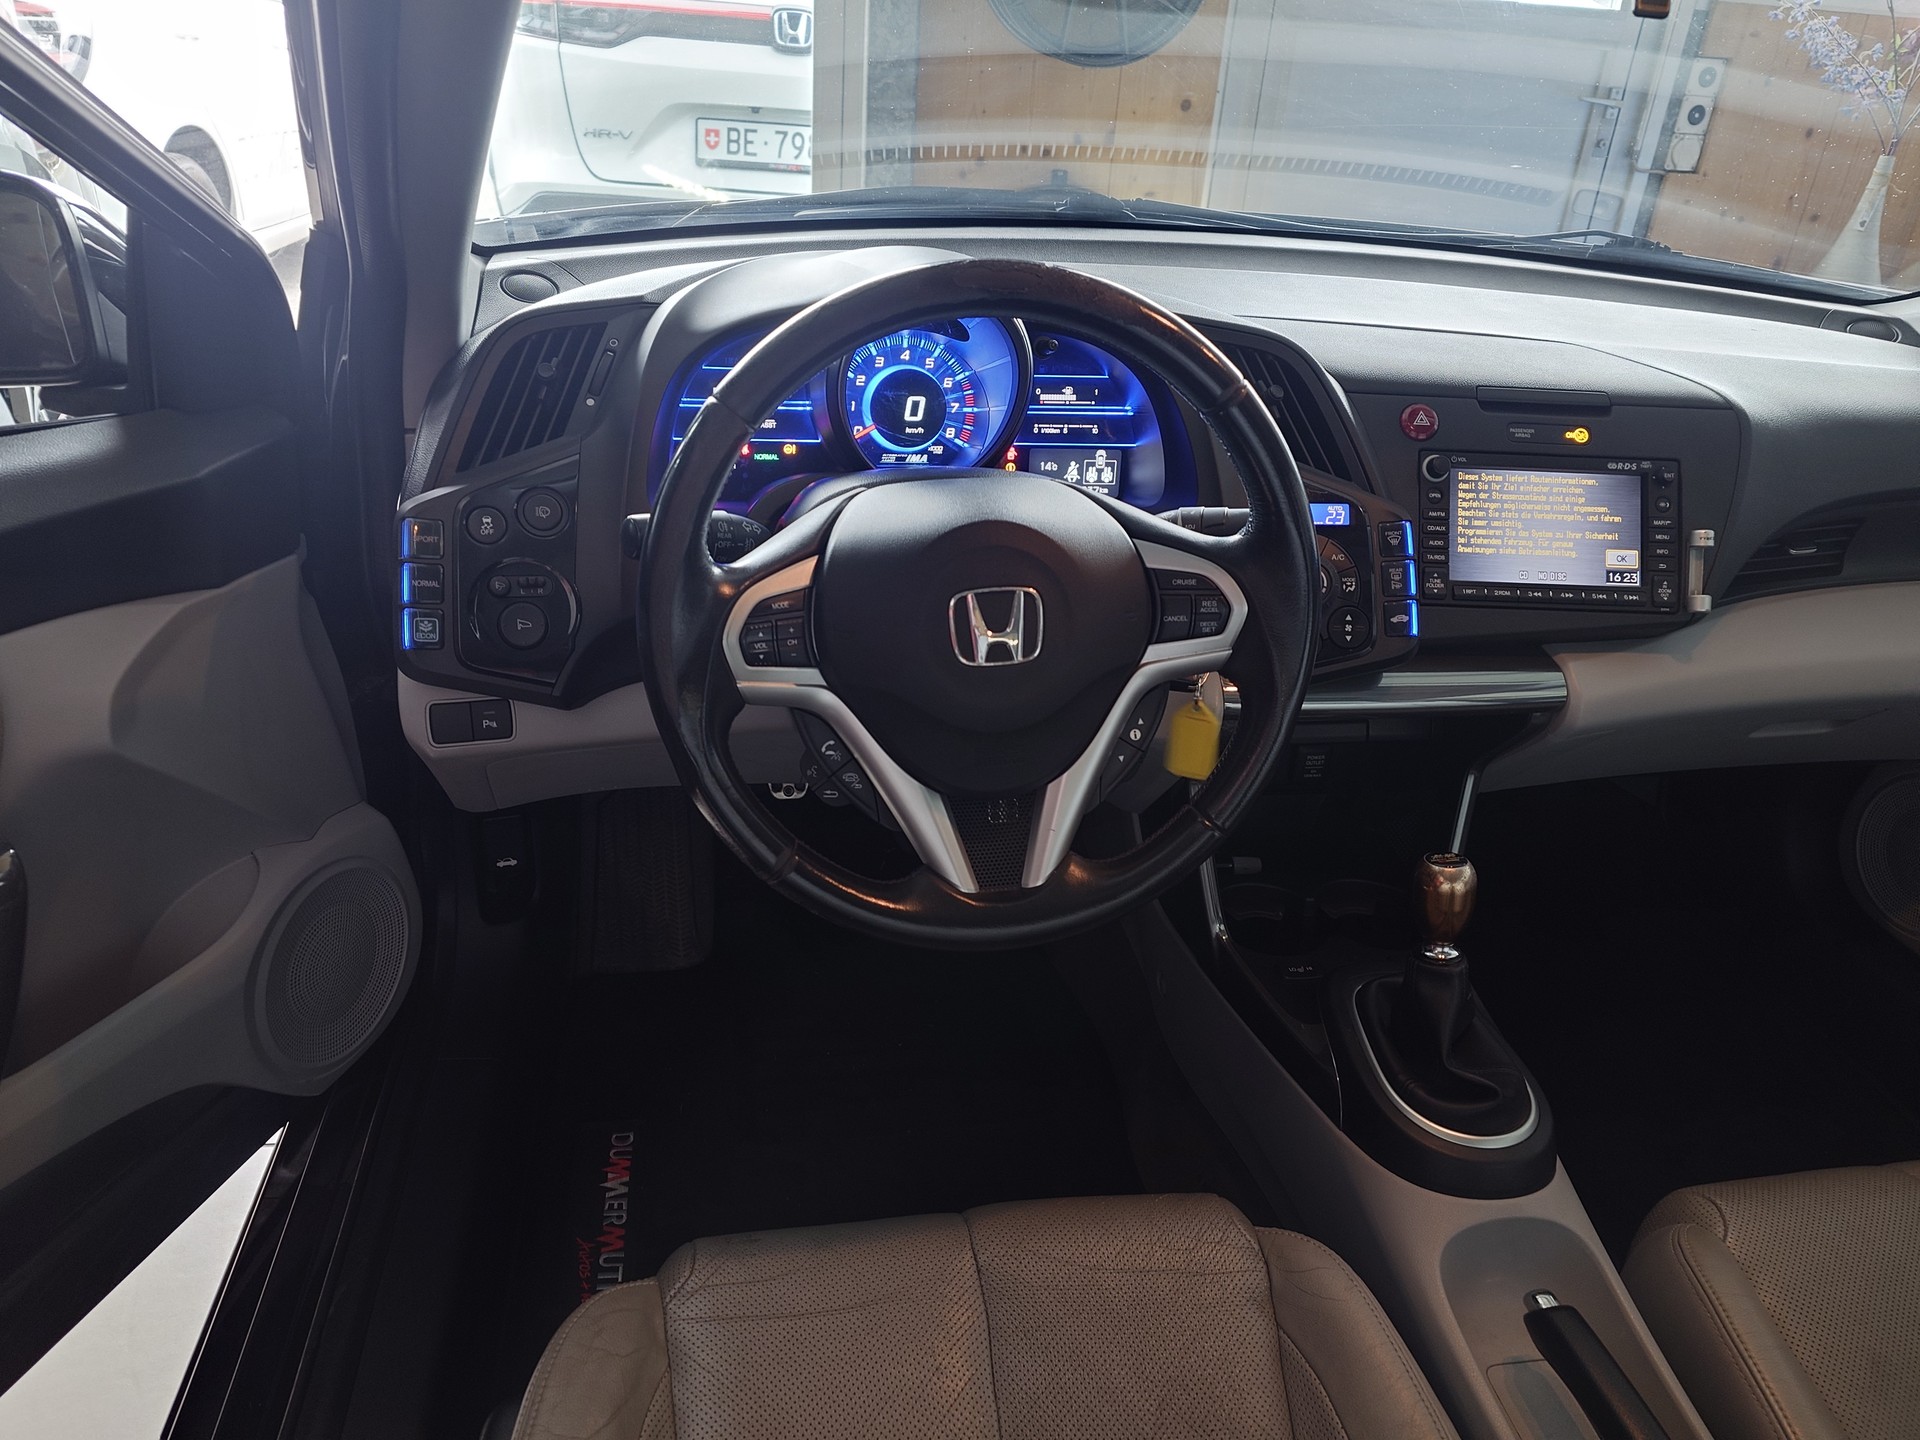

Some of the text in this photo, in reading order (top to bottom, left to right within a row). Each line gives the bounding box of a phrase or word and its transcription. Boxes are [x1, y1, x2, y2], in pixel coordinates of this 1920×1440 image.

[583, 127, 634, 140] HR-V
[900, 349, 911, 361] 4
[874, 356, 885, 368] 3
[924, 357, 935, 369] 5
[855, 374, 866, 386] 2
[943, 377, 954, 388] 6
[850, 400, 856, 412] 1
[903, 395, 927, 422] 0
[950, 402, 960, 413] 7
[945, 427, 956, 439] 8
[753, 453, 779, 461] NORMAL
[904, 454, 929, 462] IMA
[1458, 471, 1479, 481] Dieses
[1481, 472, 1503, 482] System
[1506, 473, 1528, 483] liefert
[1458, 481, 1476, 490] damit
[1477, 482, 1489, 490] Sie
[1491, 482, 1502, 490] Ihr
[1503, 482, 1518, 491] Ziel
[1519, 484, 1551, 493] einfacher
[1458, 489, 1477, 499] Wegen
[1478, 491, 1490, 499] der
[1549, 494, 1564, 503] sind
[1565, 495, 1586, 504] einige
[1458, 499, 1502, 510] Empfehlungen
[1553, 503, 1571, 512] nicht
[1325, 511, 1346, 525] 23
[1457, 507, 1487, 517] Beachten
[1488, 509, 1500, 518] Sie
[1501, 510, 1519, 519] stets
[1520, 511, 1532, 519] die
[1586, 514, 1599, 522] und
[1600, 514, 1623, 523] fahren
[1457, 517, 1525, 529] Sie immer umsichtig.
[413, 535, 439, 543] SPORT
[1457, 526, 1504, 537] Programmieren
[1505, 528, 1517, 537] Sie
[1531, 529, 1554, 539] System
[1555, 531, 1565, 539] zu
[1566, 530, 1584, 540] Ihrer
[1584, 531, 1619, 541] Sicherheit
[1457, 535, 1468, 544] bei
[1538, 538, 1550, 547] Für
[1457, 544, 1498, 555] Anweisungen
[1499, 546, 1517, 555] siehe
[1616, 554, 1628, 563] OK
[1519, 570, 1568, 581] CD NO DISC
[412, 579, 440, 588] NORMAL
[1172, 578, 1197, 586] CRUISE
[771, 601, 791, 609] MODE
[416, 632, 437, 640] ECON
[753, 641, 769, 650] VOL
[787, 639, 798, 647] CH
